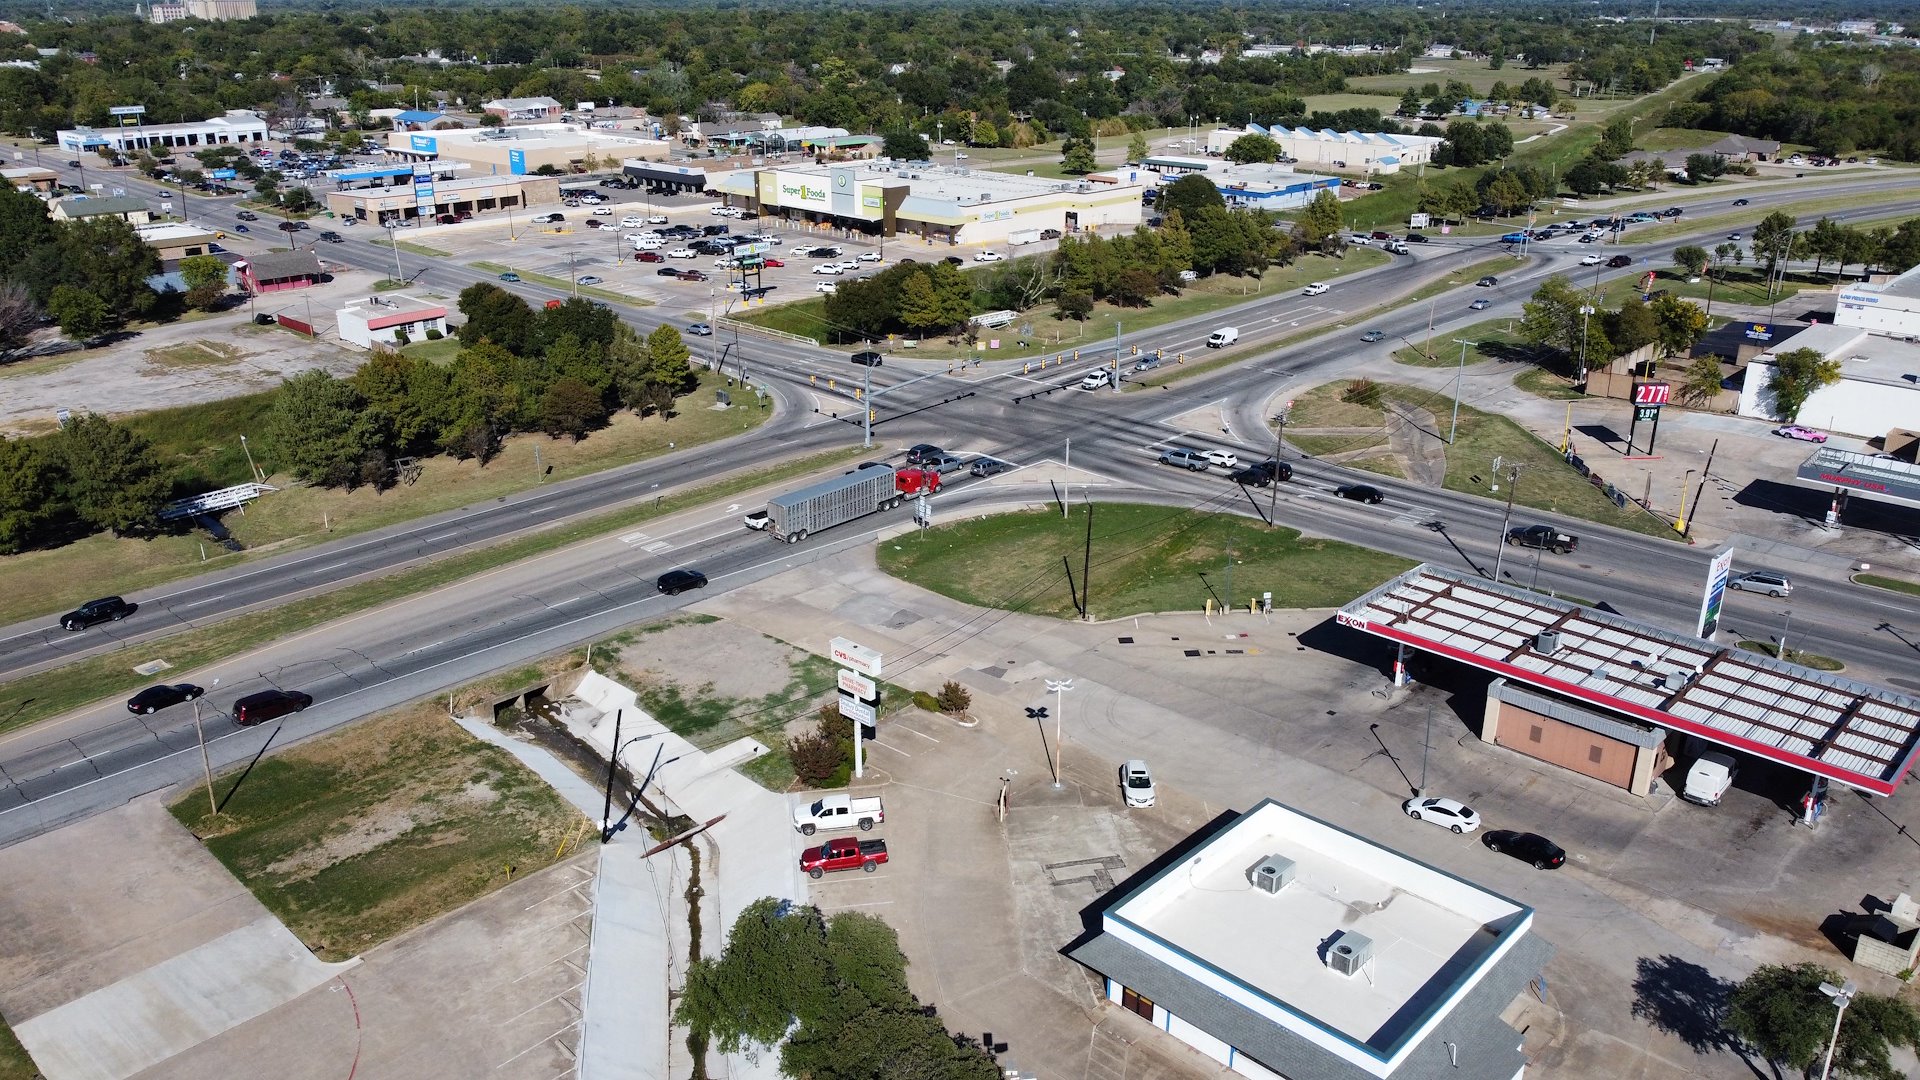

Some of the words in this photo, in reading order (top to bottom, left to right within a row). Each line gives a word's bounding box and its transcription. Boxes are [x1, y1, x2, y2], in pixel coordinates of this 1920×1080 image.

[782, 185, 801, 196] Super
[800, 185, 807, 199] 1
[806, 188, 826, 198] Foods
[1820, 472, 1862, 486] MURPHY
[1864, 482, 1886, 492] USA
[1338, 614, 1366, 629] EXXON
[842, 682, 867, 696] PHARMACY
